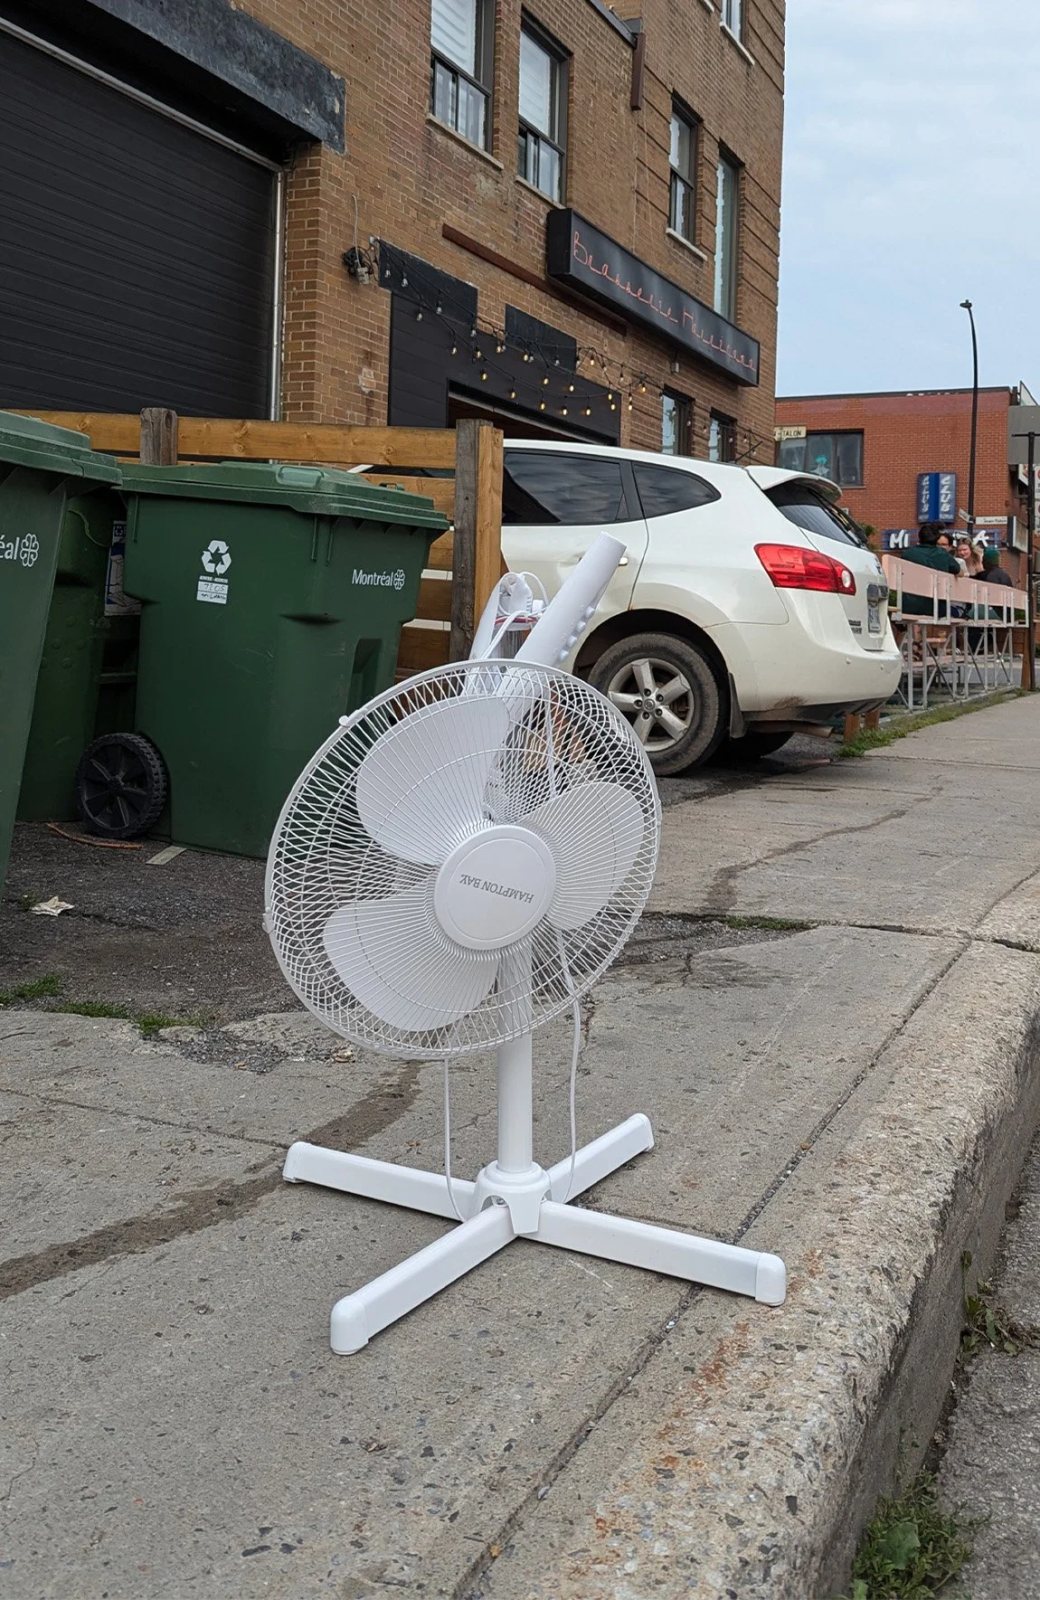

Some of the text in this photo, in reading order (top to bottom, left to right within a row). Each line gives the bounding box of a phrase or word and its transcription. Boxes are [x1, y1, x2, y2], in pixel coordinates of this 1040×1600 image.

[351, 568, 394, 586] Montréal
[459, 874, 534, 903] HAMPTON BAY
